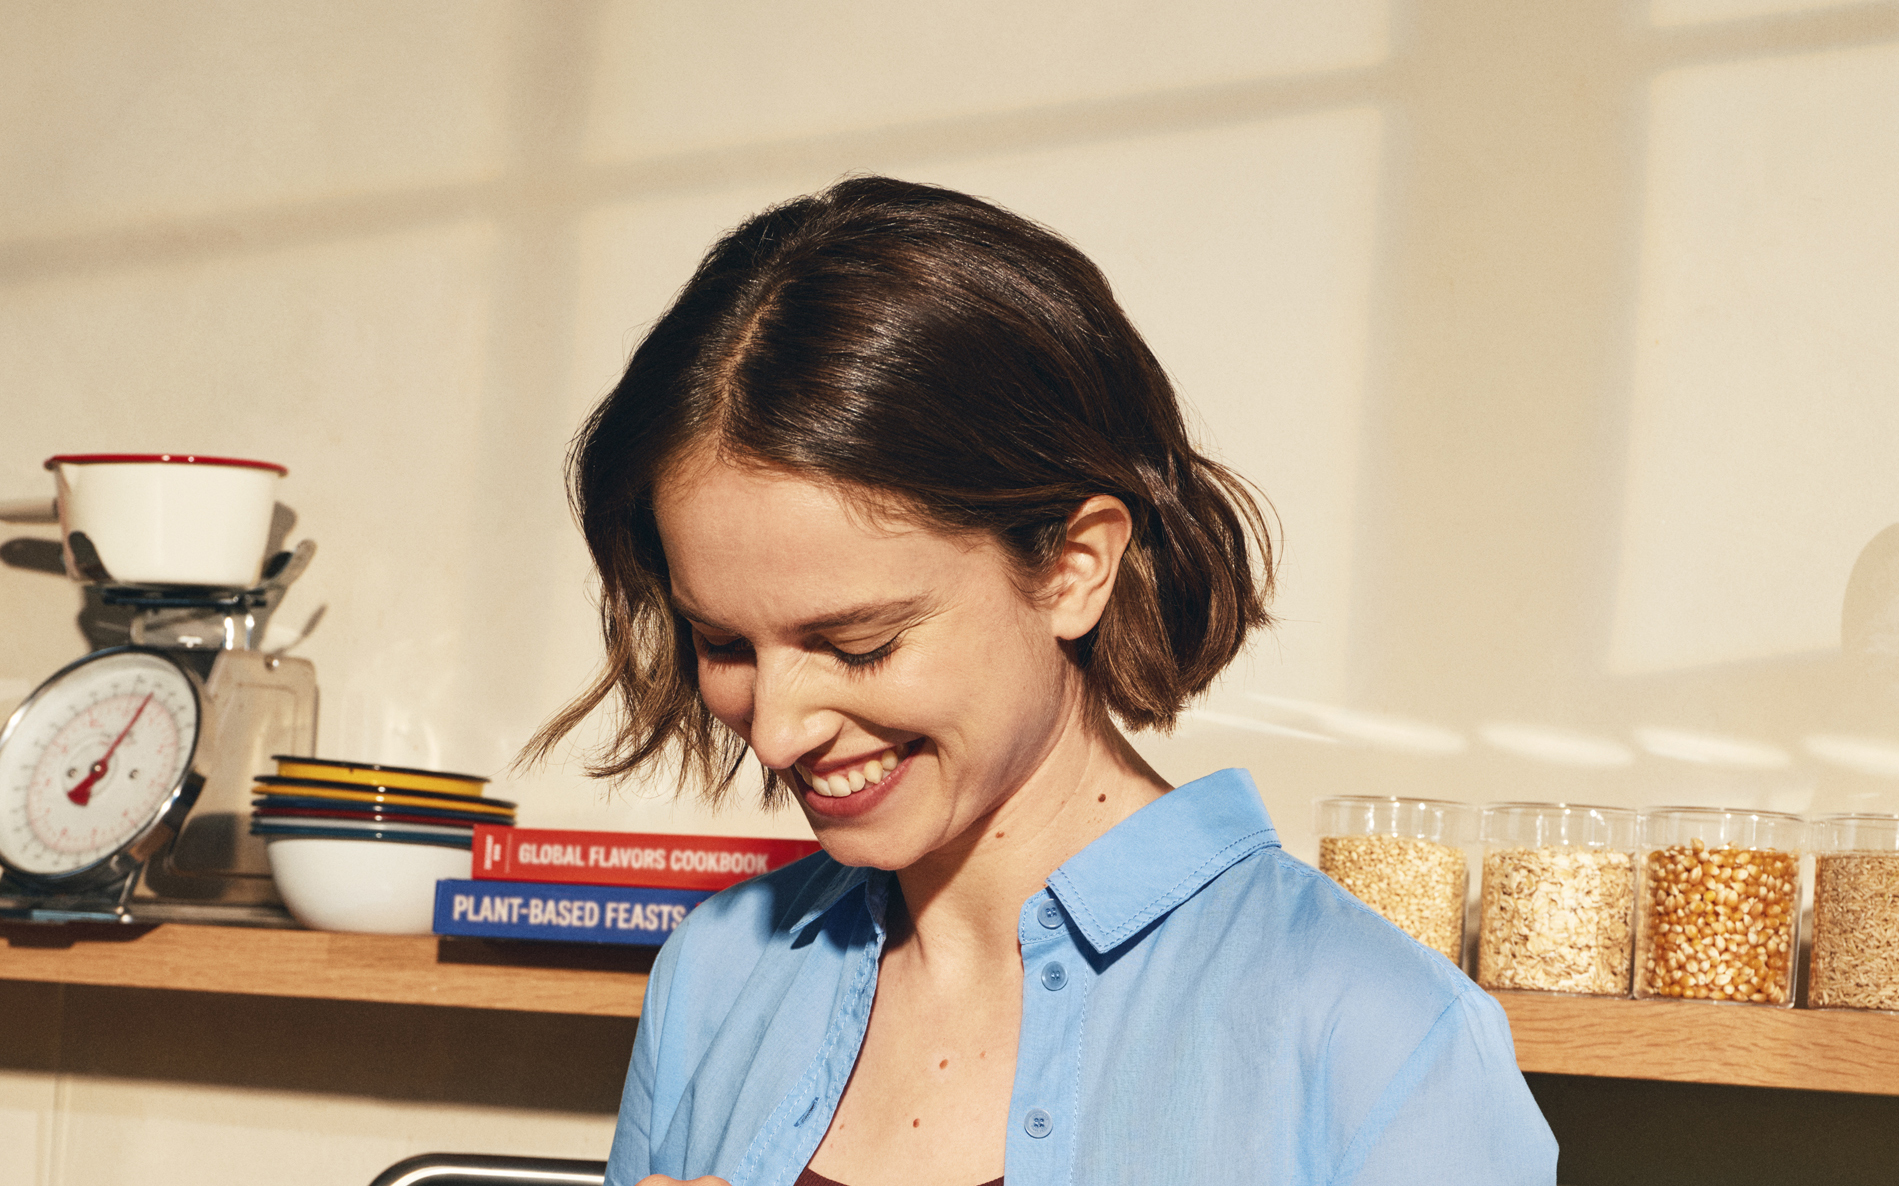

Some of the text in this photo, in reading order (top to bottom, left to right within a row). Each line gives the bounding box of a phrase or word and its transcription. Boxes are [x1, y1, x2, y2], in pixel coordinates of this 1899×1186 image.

[518, 842, 584, 867] GLOBAL
[588, 846, 666, 871] FLAVORS
[670, 849, 769, 875] COOKBOOK
[453, 894, 686, 932] PLANT-BASED FEASTS
